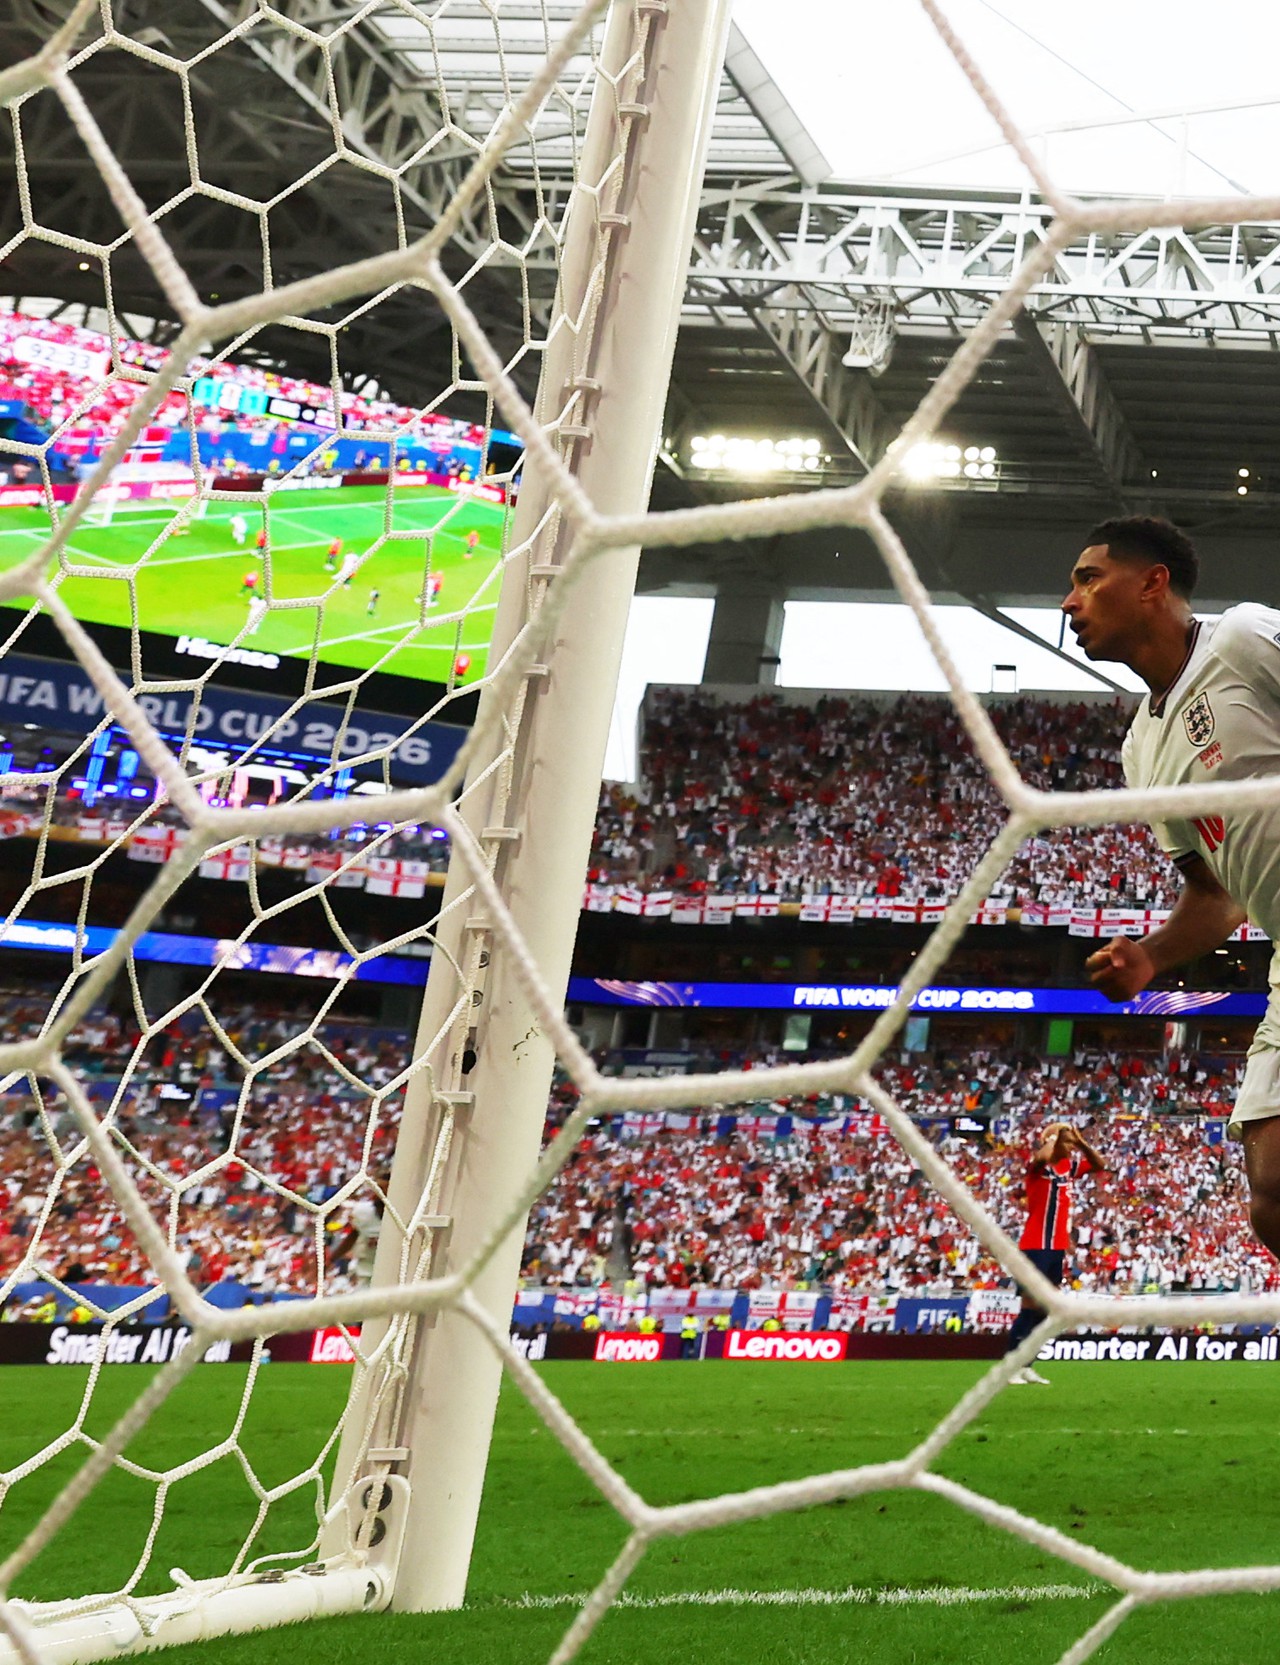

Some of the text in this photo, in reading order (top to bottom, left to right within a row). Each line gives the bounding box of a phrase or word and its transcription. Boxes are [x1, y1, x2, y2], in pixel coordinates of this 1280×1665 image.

[175, 635, 280, 670] Hisense
[0, 673, 432, 766] IFA WRLD CUP 2026
[793, 987, 1035, 1010] FIFA WORL CUP 2026
[917, 1308, 951, 1327] FIF
[140, 1327, 173, 1363] AI
[596, 1334, 660, 1361] Lenovo
[727, 1332, 842, 1360] Lenovo
[1037, 1336, 1278, 1361] Smarter AI for all
